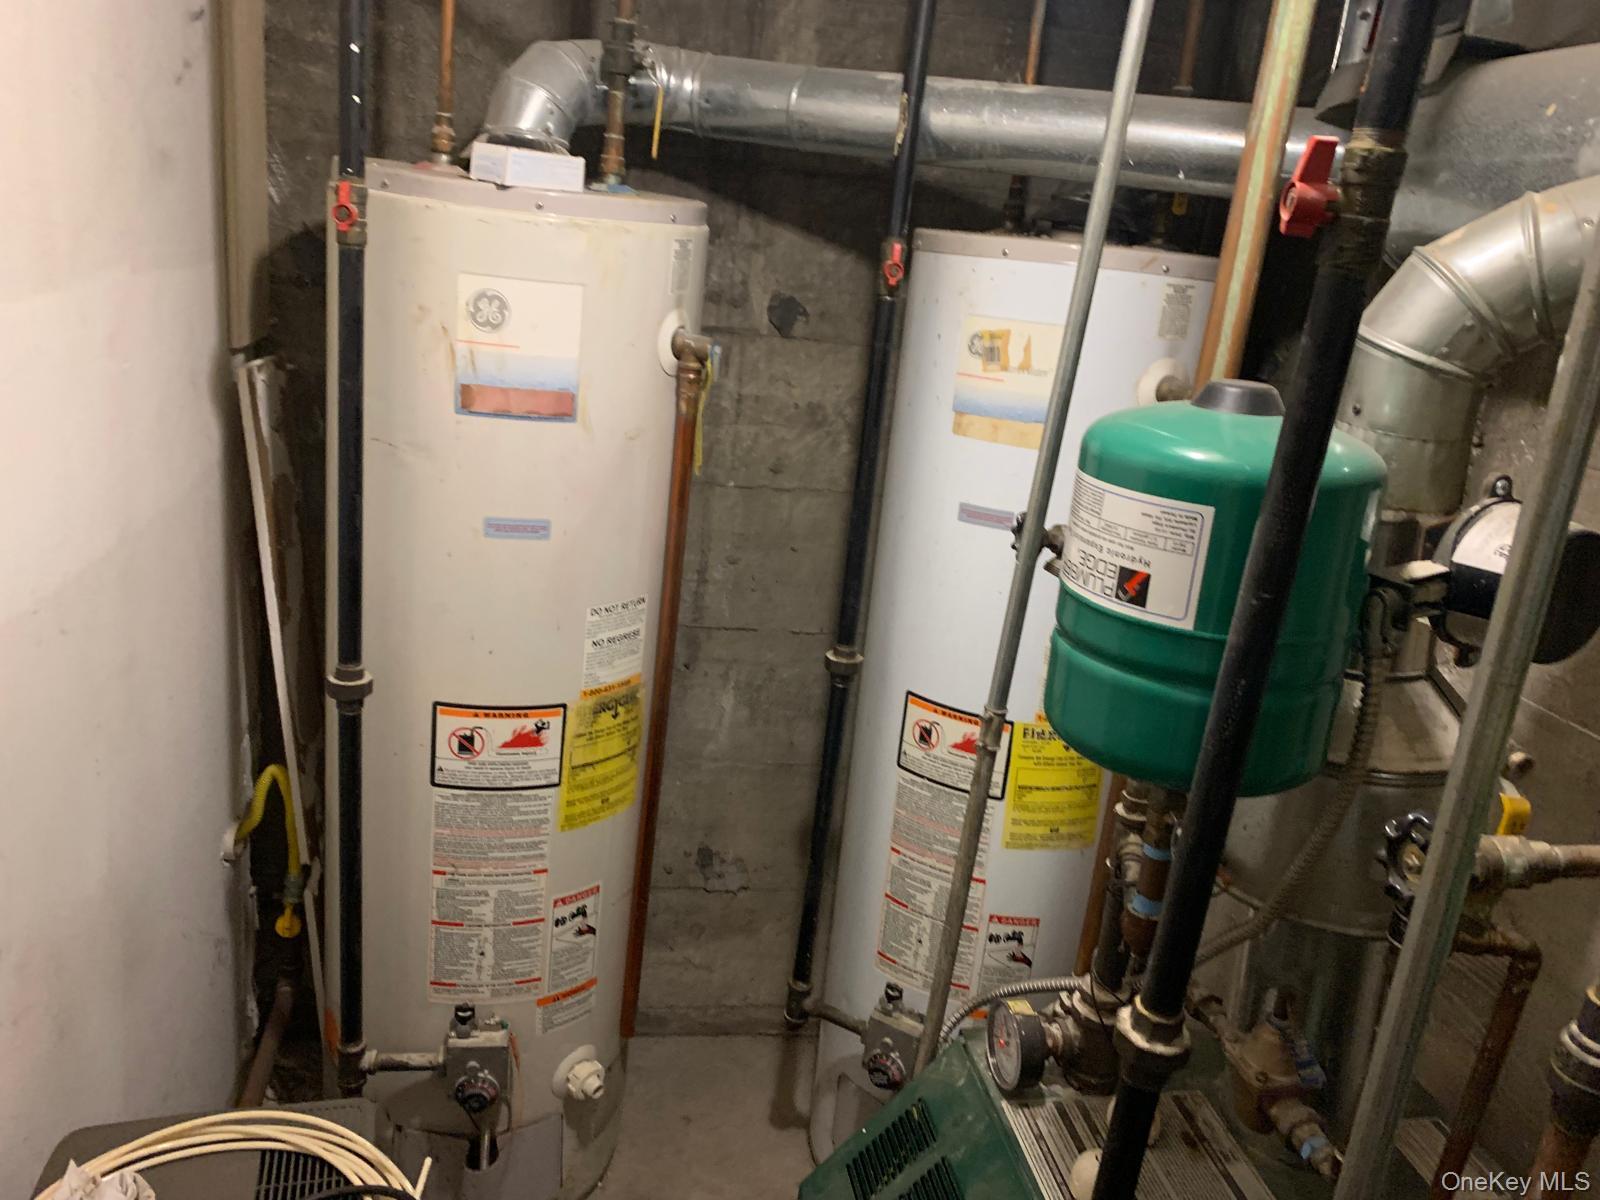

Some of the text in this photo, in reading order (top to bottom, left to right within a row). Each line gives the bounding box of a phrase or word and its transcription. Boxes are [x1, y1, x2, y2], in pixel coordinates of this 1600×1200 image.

[1079, 549, 1117, 579] EDGE
[590, 597, 646, 617] DO NOT RETURN
[592, 639, 604, 649] NO
[482, 711, 529, 719] WARNING
[941, 710, 980, 727] WARNING
[564, 886, 599, 906] DANGER
[999, 917, 1040, 926] DANGER
